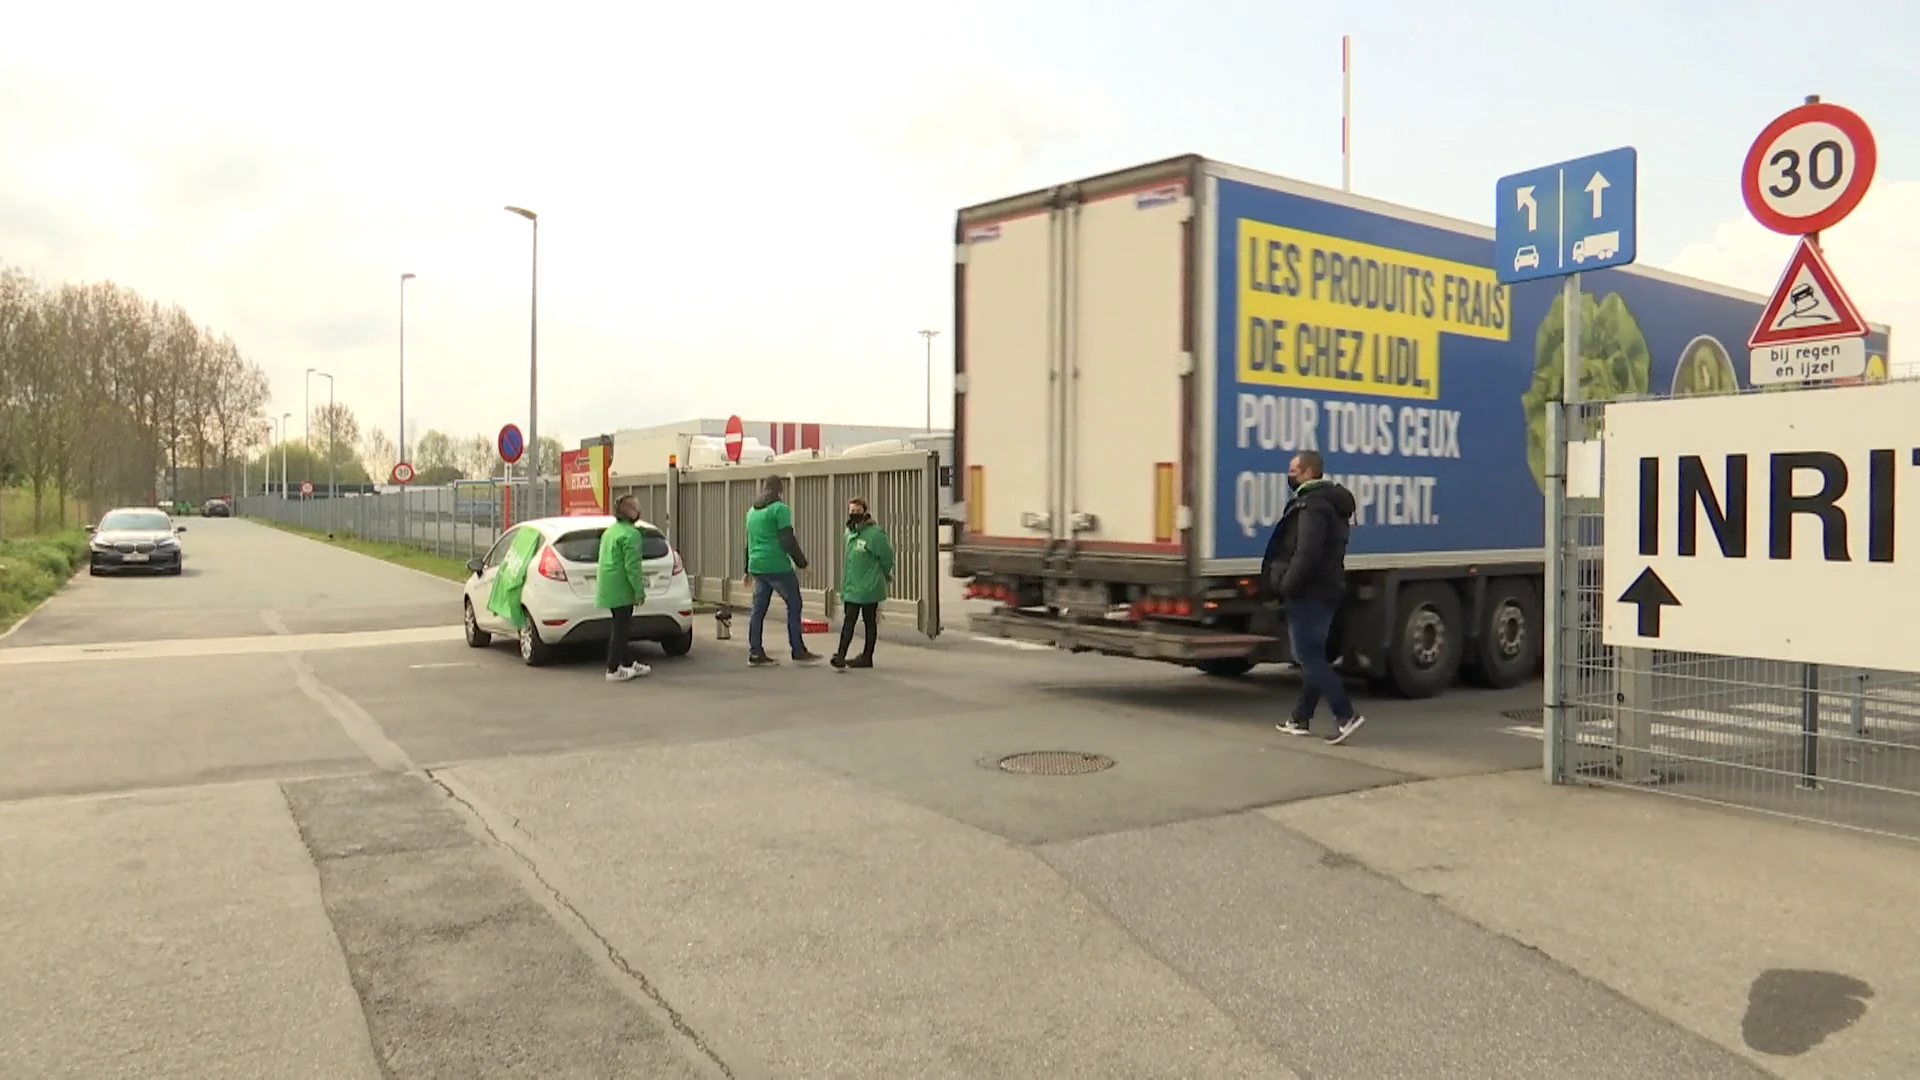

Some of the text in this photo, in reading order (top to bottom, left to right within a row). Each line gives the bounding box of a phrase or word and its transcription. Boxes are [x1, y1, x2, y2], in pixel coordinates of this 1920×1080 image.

[1768, 140, 1843, 198] 30
[1250, 236, 1505, 330] LES PRODUITS FRAIS
[1250, 316, 1287, 374] DE
[1297, 322, 1363, 382] CHEZ
[1770, 344, 1840, 364] bij regen
[1776, 360, 1834, 378] en ijzel
[1236, 393, 1461, 459] POUR TOUS CEUX
[1639, 448, 1920, 563] INRI
